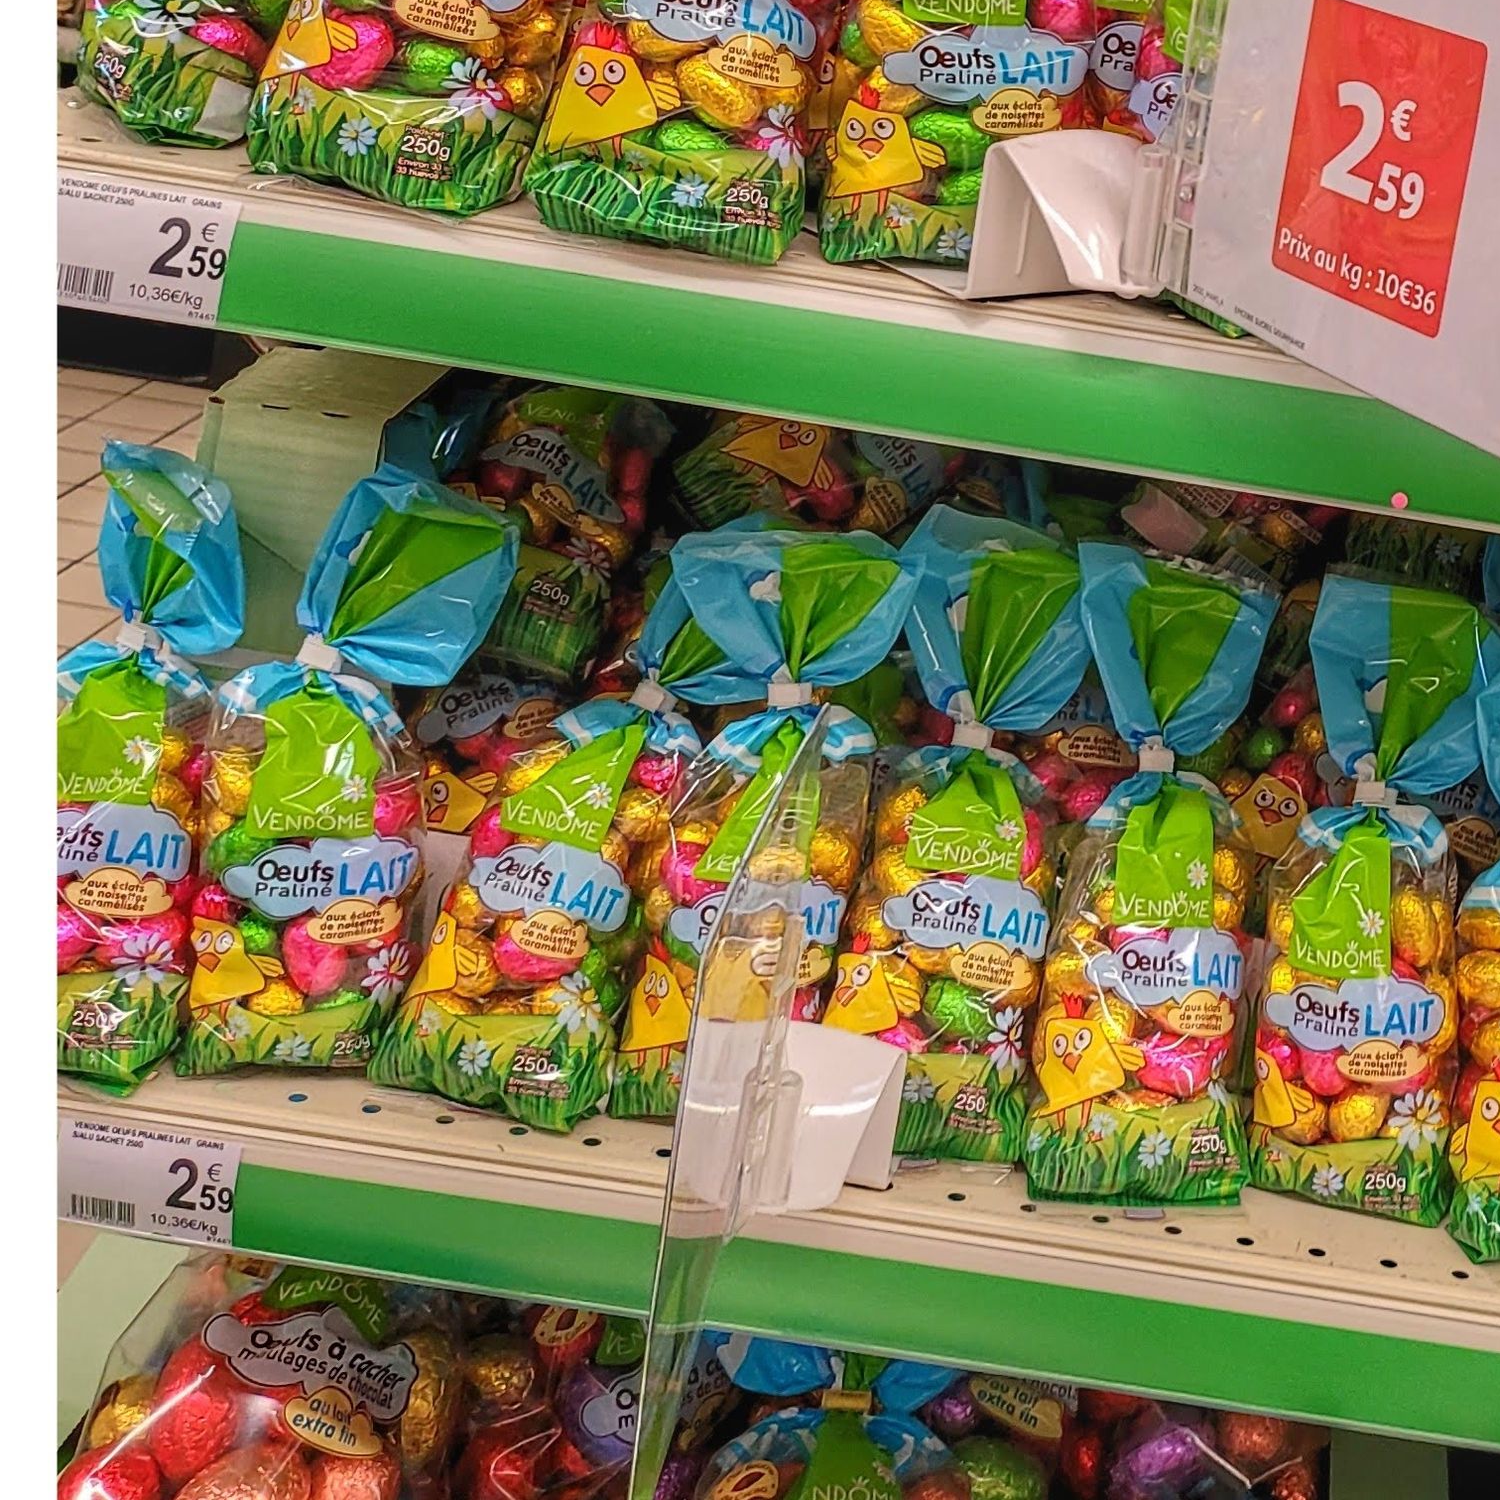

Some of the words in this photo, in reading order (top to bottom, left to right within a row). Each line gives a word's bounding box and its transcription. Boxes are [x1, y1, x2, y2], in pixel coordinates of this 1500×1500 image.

[919, 68, 997, 86] Praliné
[999, 50, 1075, 85] LAIT
[1390, 99, 1418, 142] €
[400, 133, 452, 162] 250g
[1319, 79, 1386, 205] 2
[60, 177, 100, 192] VENDOME
[101, 182, 128, 196] OEUFS
[128, 187, 169, 202] PRALINES
[169, 193, 188, 205] LAIT
[192, 197, 224, 210] GRAINS
[82, 191, 115, 204] SACHET
[726, 186, 769, 208] 250g
[1372, 161, 1426, 220] 59
[148, 216, 192, 279] 2
[201, 222, 219, 243] €
[187, 245, 228, 281] 59
[1279, 227, 1313, 264] Prix
[1313, 247, 1339, 274] au
[1339, 252, 1363, 291] kg
[1375, 268, 1438, 317] 10€36
[129, 283, 204, 311] 10,36€/kg
[529, 579, 571, 607] 250g
[253, 803, 369, 833] VENDÔME
[506, 799, 602, 843] VENDÔME
[104, 829, 187, 870] LAIT
[912, 834, 1018, 872] VENDÔME
[254, 882, 332, 899] Praliné
[484, 870, 546, 903] Praliné
[549, 872, 625, 925] LAIT
[982, 903, 1047, 949] LAIT
[1296, 934, 1386, 971] VENDÔME
[1192, 953, 1242, 990] LAIT
[1363, 998, 1436, 1038] LAIT
[74, 1120, 111, 1134] VENDOME
[111, 1126, 137, 1138] OEUFS
[138, 1129, 175, 1143] PRALINES
[175, 1135, 192, 1146] LAIT
[196, 1139, 225, 1151] GRAINS
[95, 1134, 125, 1147] SACHET
[1190, 1135, 1227, 1156] 250g
[165, 1157, 199, 1212] 2
[207, 1163, 224, 1183] €
[1364, 1171, 1407, 1193] 250g
[199, 1184, 235, 1214] 59
[150, 1212, 218, 1237] 10,36€/kg
[279, 1274, 384, 1336] VENDÔME
[347, 1350, 405, 1392] cacher
[292, 1413, 337, 1438] extra
